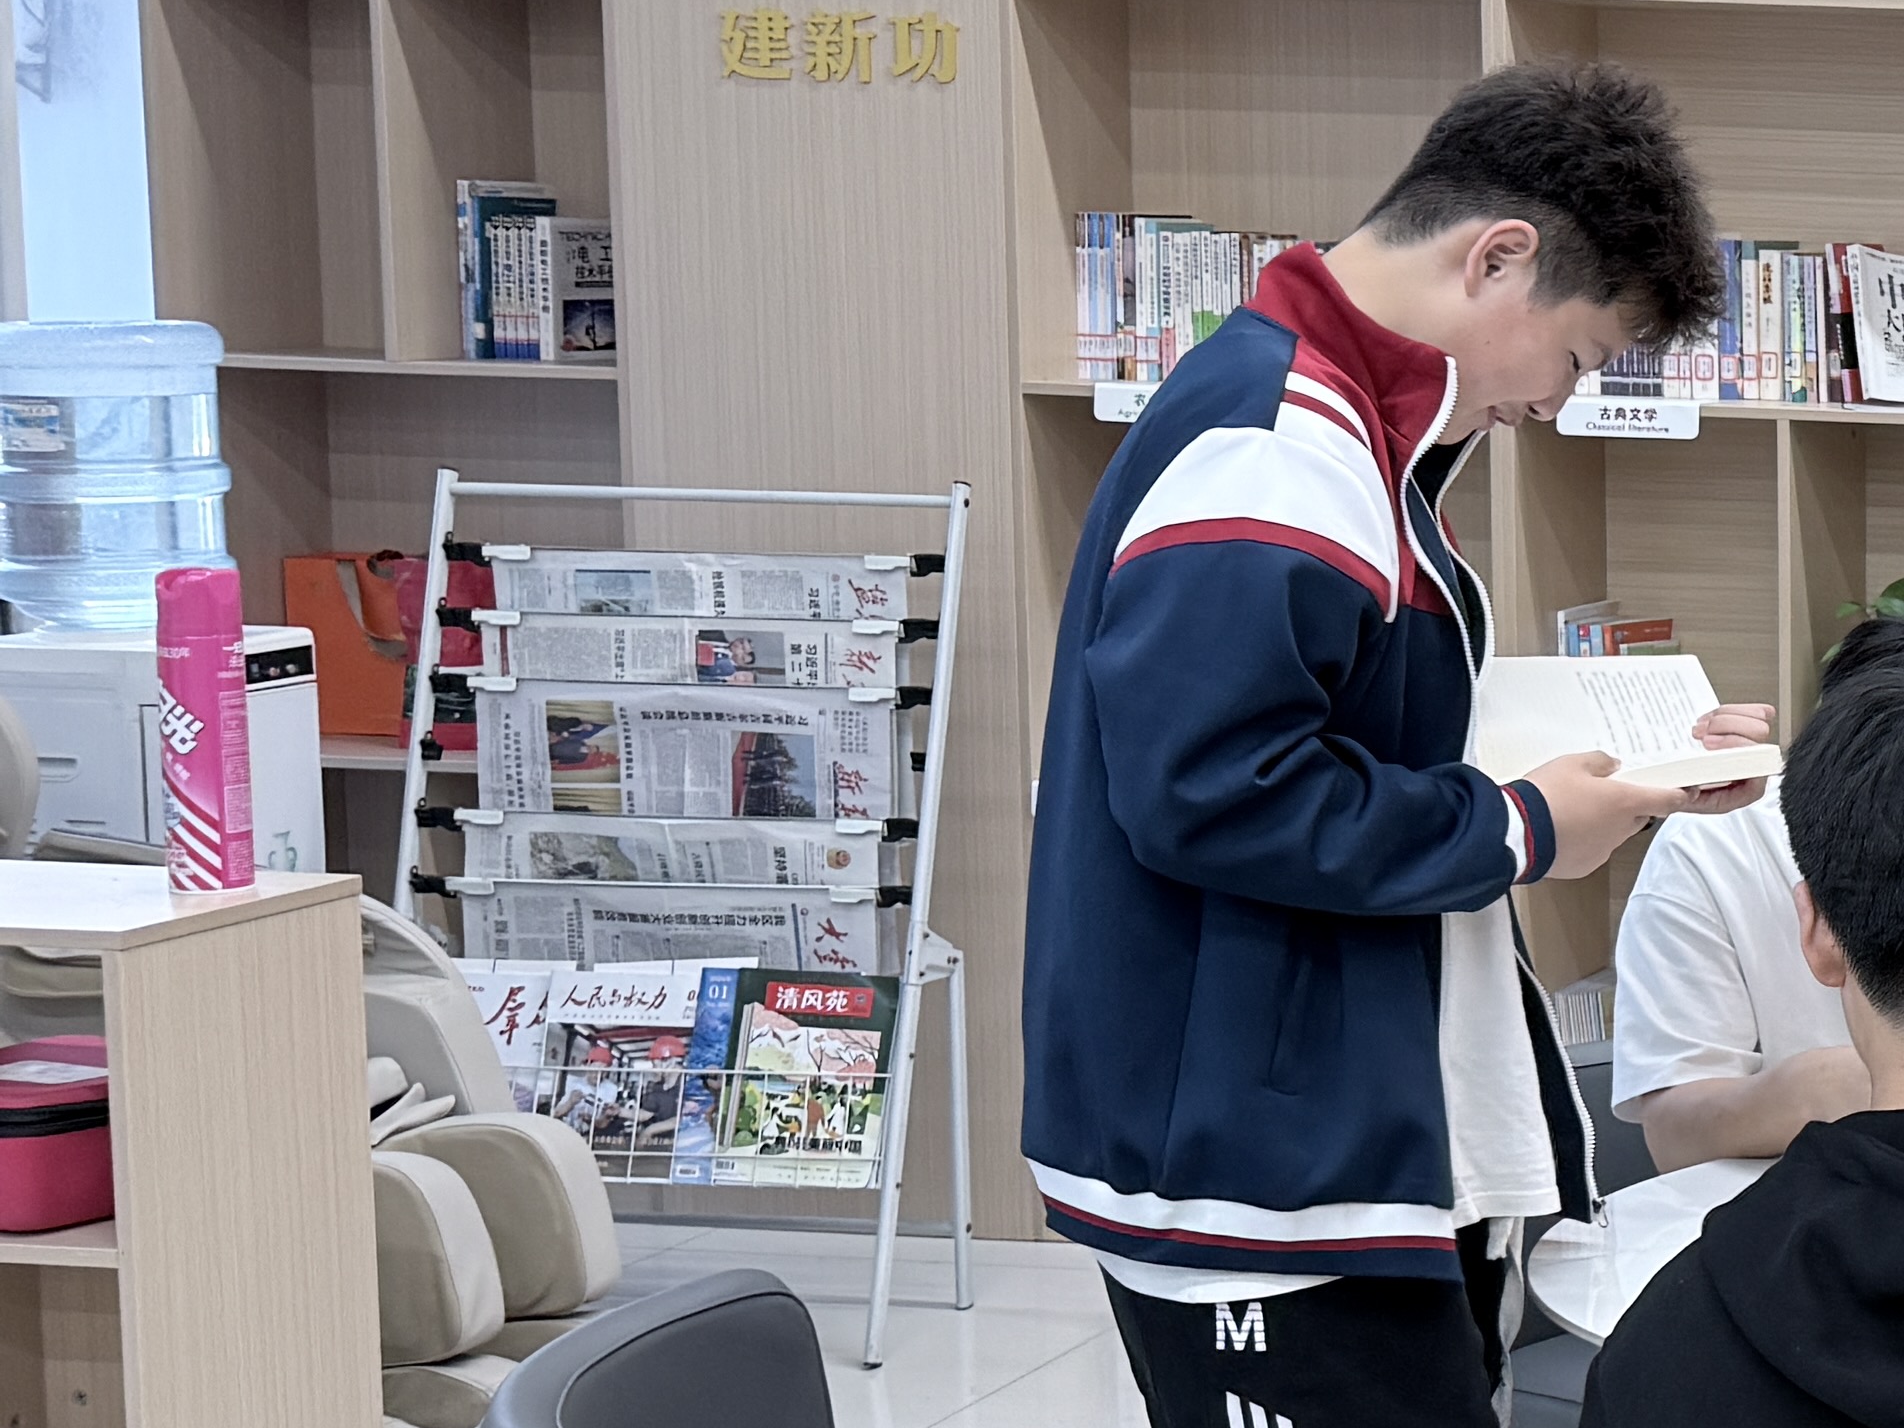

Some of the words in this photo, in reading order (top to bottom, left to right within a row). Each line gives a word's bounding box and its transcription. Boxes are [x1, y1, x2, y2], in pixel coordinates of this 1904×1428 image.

[720, 7, 961, 85] 建新功
[1599, 405, 1658, 423] 古典文学
[560, 984, 668, 1012] 人民与权力
[708, 985, 728, 1000] 01
[775, 986, 850, 1013] 清风苑
[1215, 1301, 1267, 1352] M
